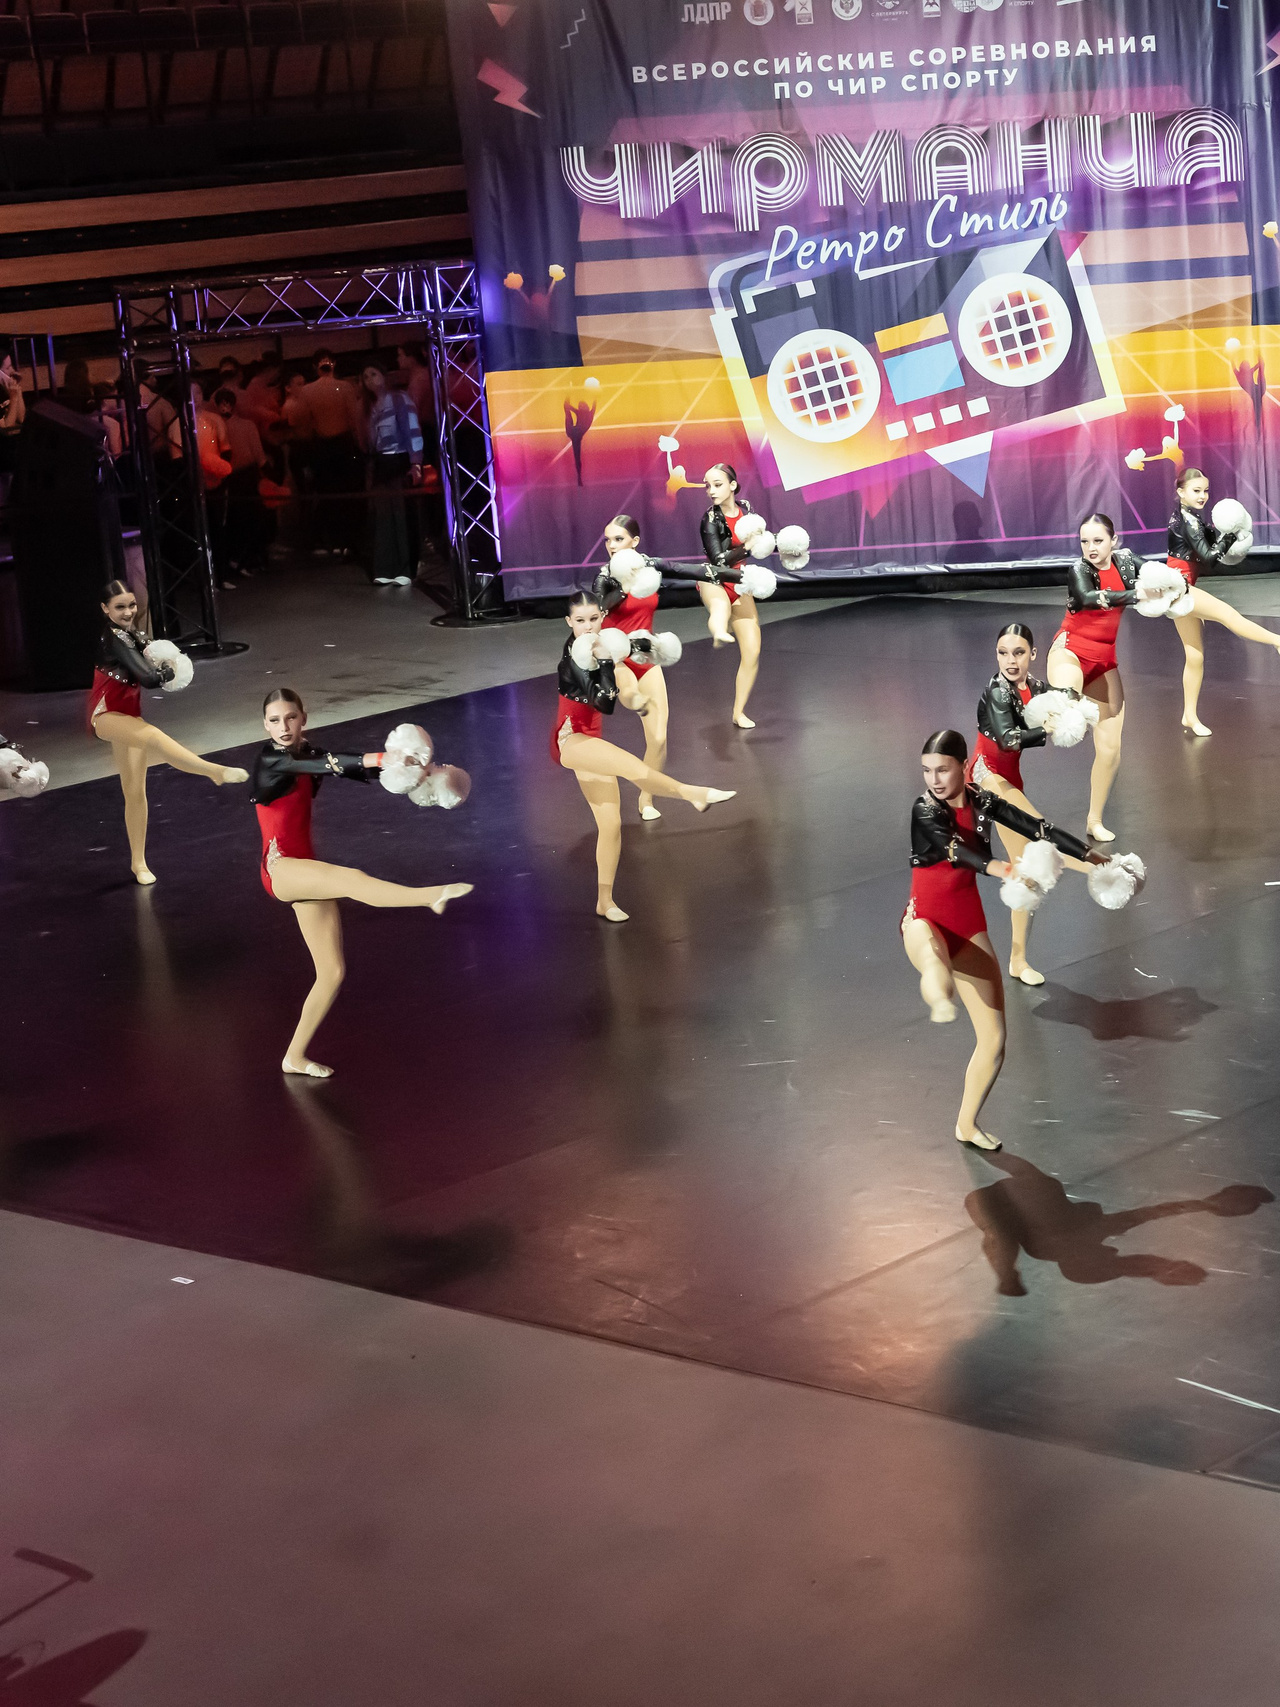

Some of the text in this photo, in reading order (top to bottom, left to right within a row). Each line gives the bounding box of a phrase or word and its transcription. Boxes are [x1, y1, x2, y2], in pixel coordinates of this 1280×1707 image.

[681, 2, 732, 25] ЛДПР
[632, 34, 1157, 83] ВСЕРОССИЙСКИЕ СОРЕВНОВАНИЯ
[774, 68, 1019, 100] ПО ЧИР СПОРТУ
[765, 193, 1069, 281] Ретро Стиль
